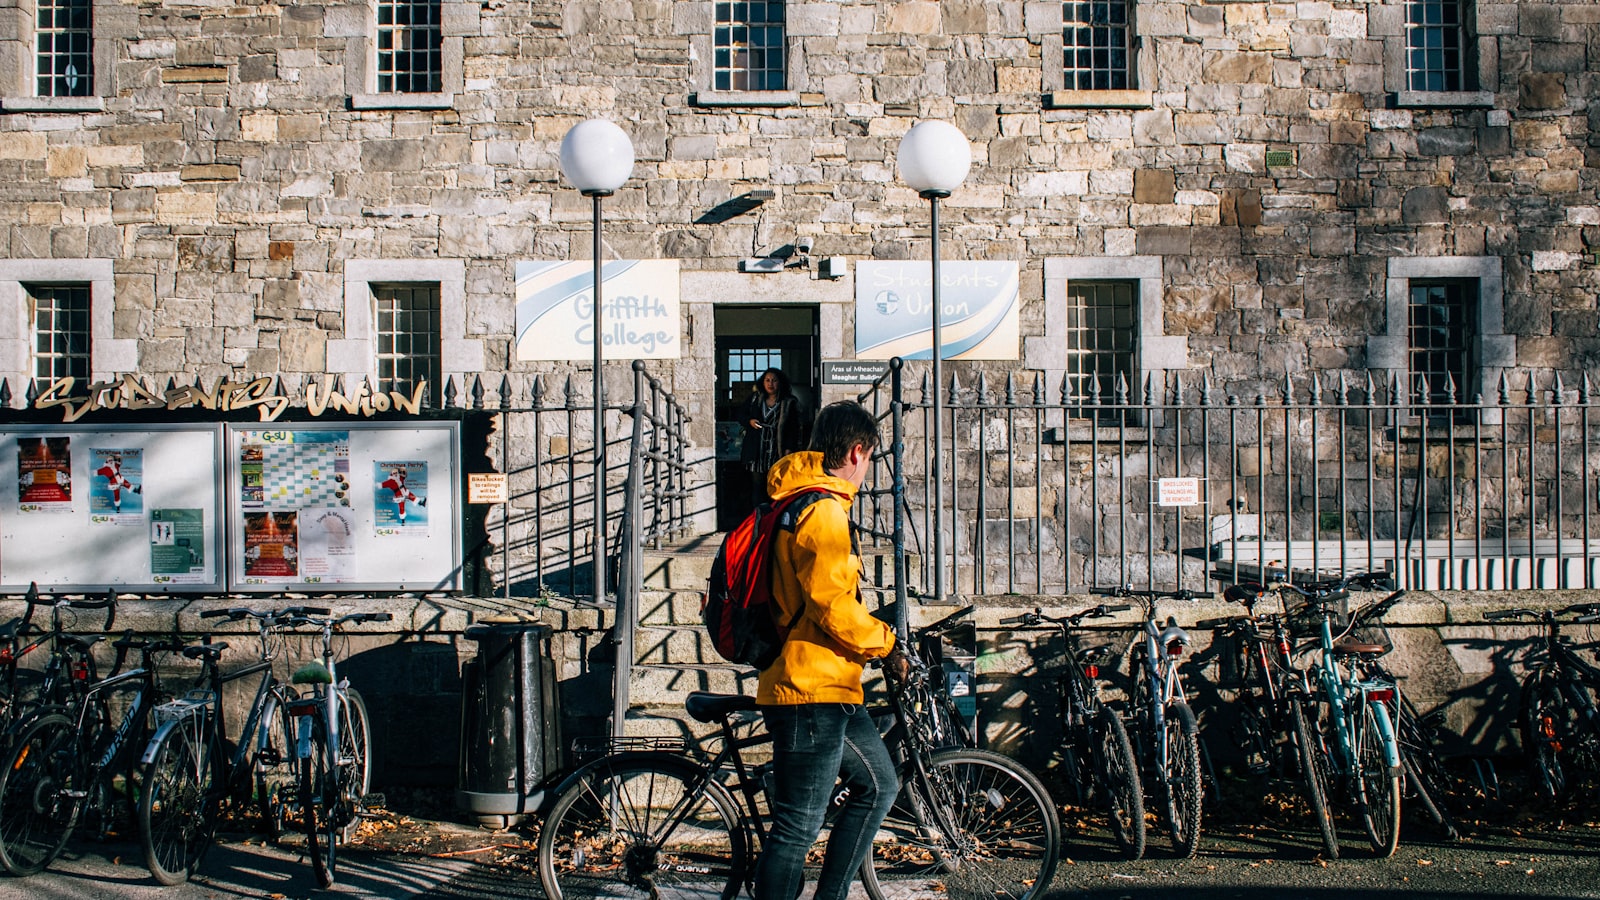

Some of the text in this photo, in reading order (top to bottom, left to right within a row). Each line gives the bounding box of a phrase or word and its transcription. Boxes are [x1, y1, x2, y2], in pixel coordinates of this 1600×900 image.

[906, 291, 970, 316] Unon
[574, 322, 674, 354] College
[853, 365, 884, 373] Mheachair
